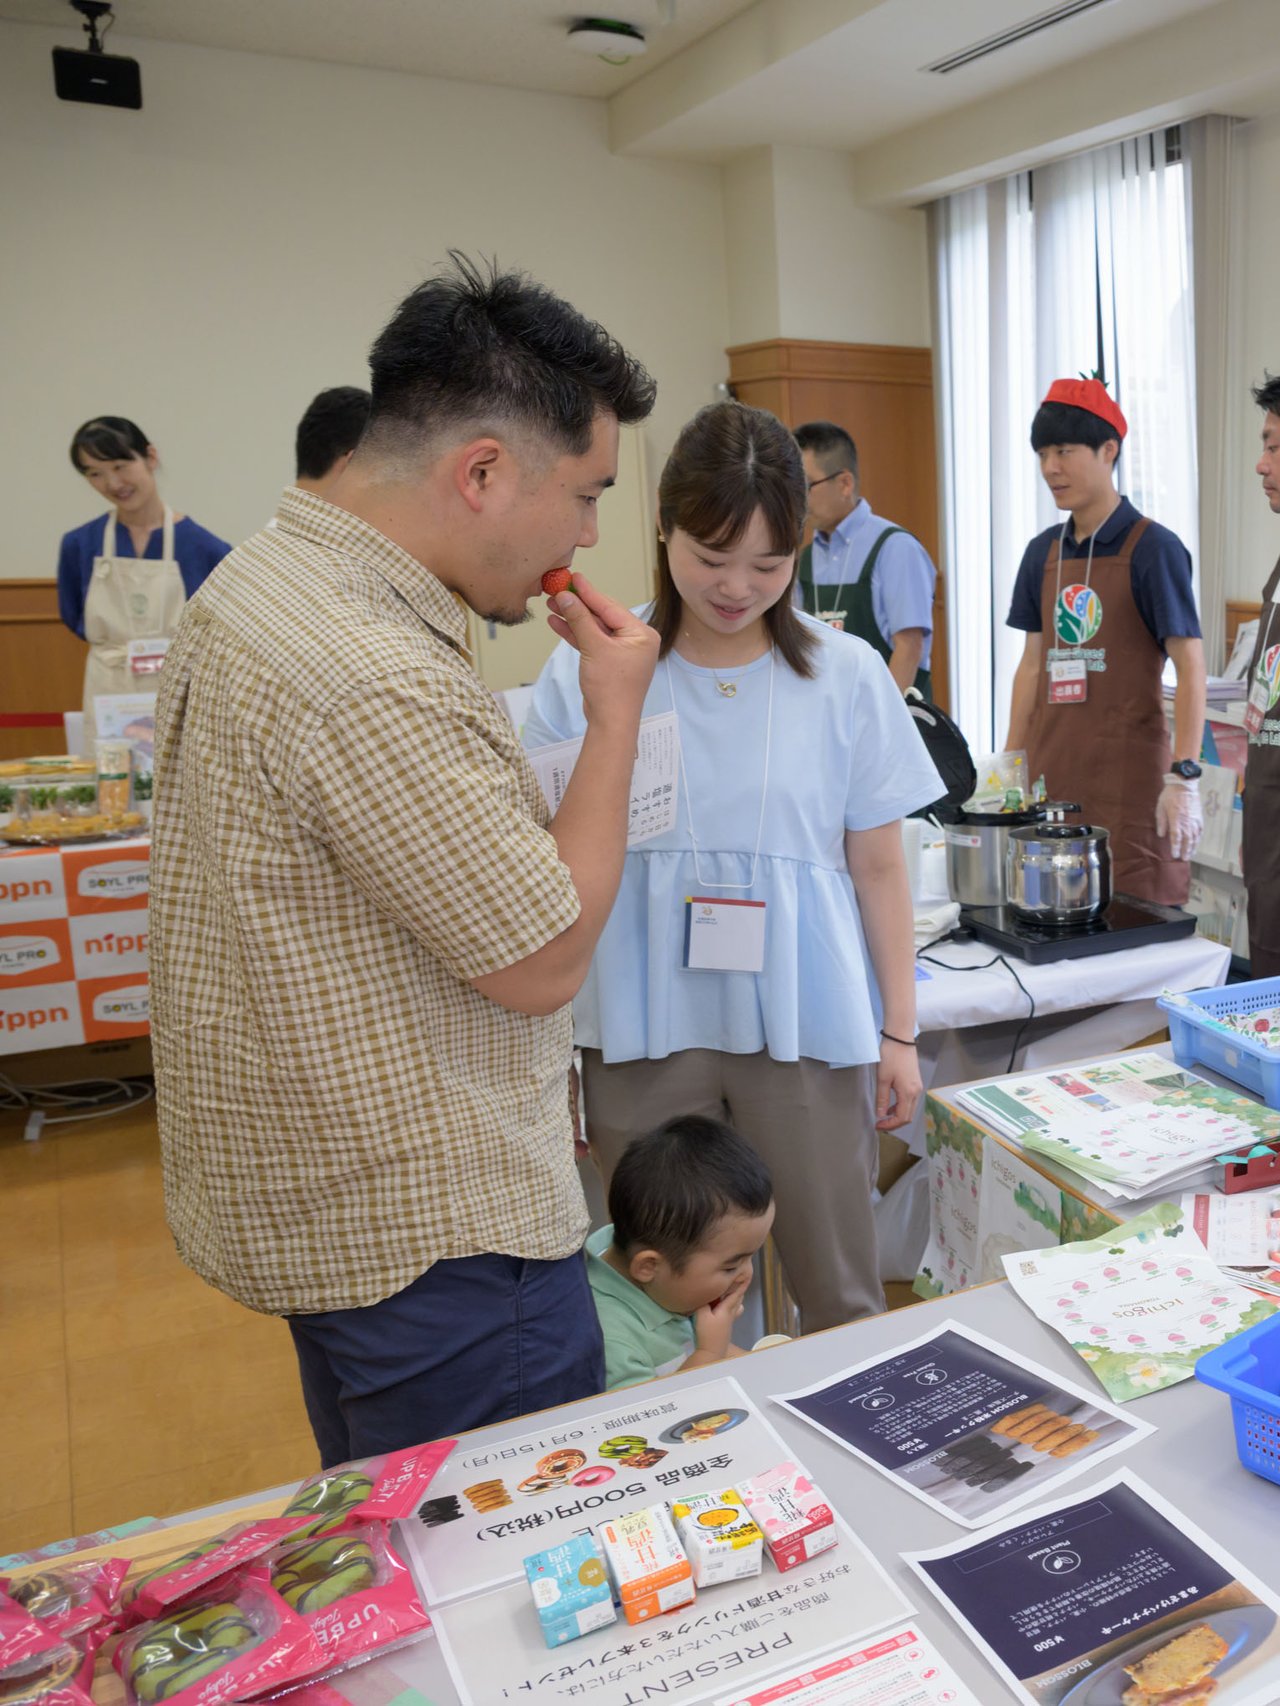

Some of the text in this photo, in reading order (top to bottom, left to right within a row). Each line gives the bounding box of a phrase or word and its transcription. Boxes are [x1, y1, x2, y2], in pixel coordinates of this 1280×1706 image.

[84, 933, 148, 955] nipp
[992, 1394, 1028, 1415] BLOSSOM
[897, 1437, 923, 1451] ¥500
[655, 1453, 734, 1487] 全商品
[1027, 1539, 1071, 1561] Plant Based
[1101, 1585, 1200, 1636] あまざけバナナケーキ
[556, 1591, 831, 1697] 商品をご購入いただいた方には、
[1033, 1635, 1065, 1653] ¥500
[622, 1631, 794, 1706] PRESENT
[1035, 1658, 1093, 1689] BLOSSOM
[198, 1672, 235, 1702] Tokyo
